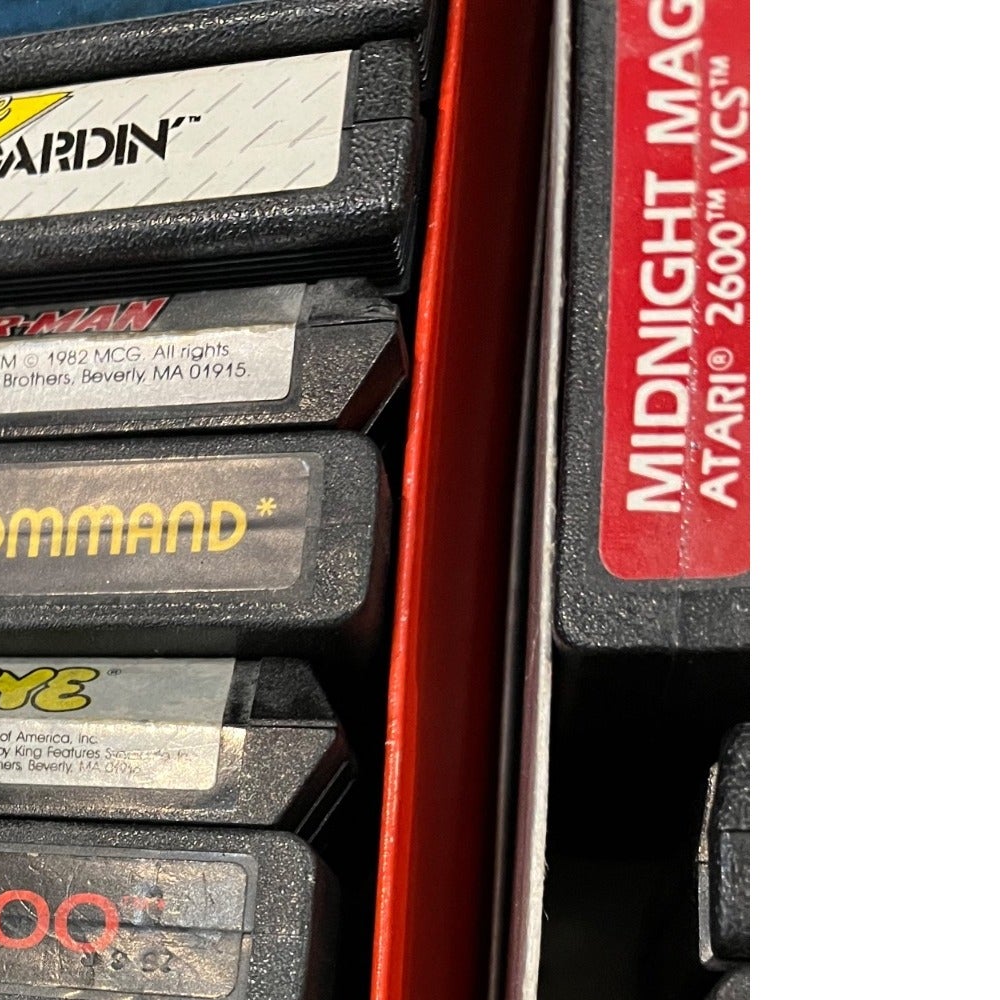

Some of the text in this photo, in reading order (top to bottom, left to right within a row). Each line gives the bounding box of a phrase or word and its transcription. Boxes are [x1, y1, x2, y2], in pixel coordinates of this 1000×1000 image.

[627, 170, 697, 512] MIDNIGHT
[48, 350, 88, 366] 1982
[153, 344, 175, 360] All
[181, 342, 230, 361] rights
[153, 365, 184, 380] MA
[189, 362, 251, 379] 01915.
[0, 731, 12, 743] of
[15, 745, 43, 760] King
[47, 746, 101, 760] Features
